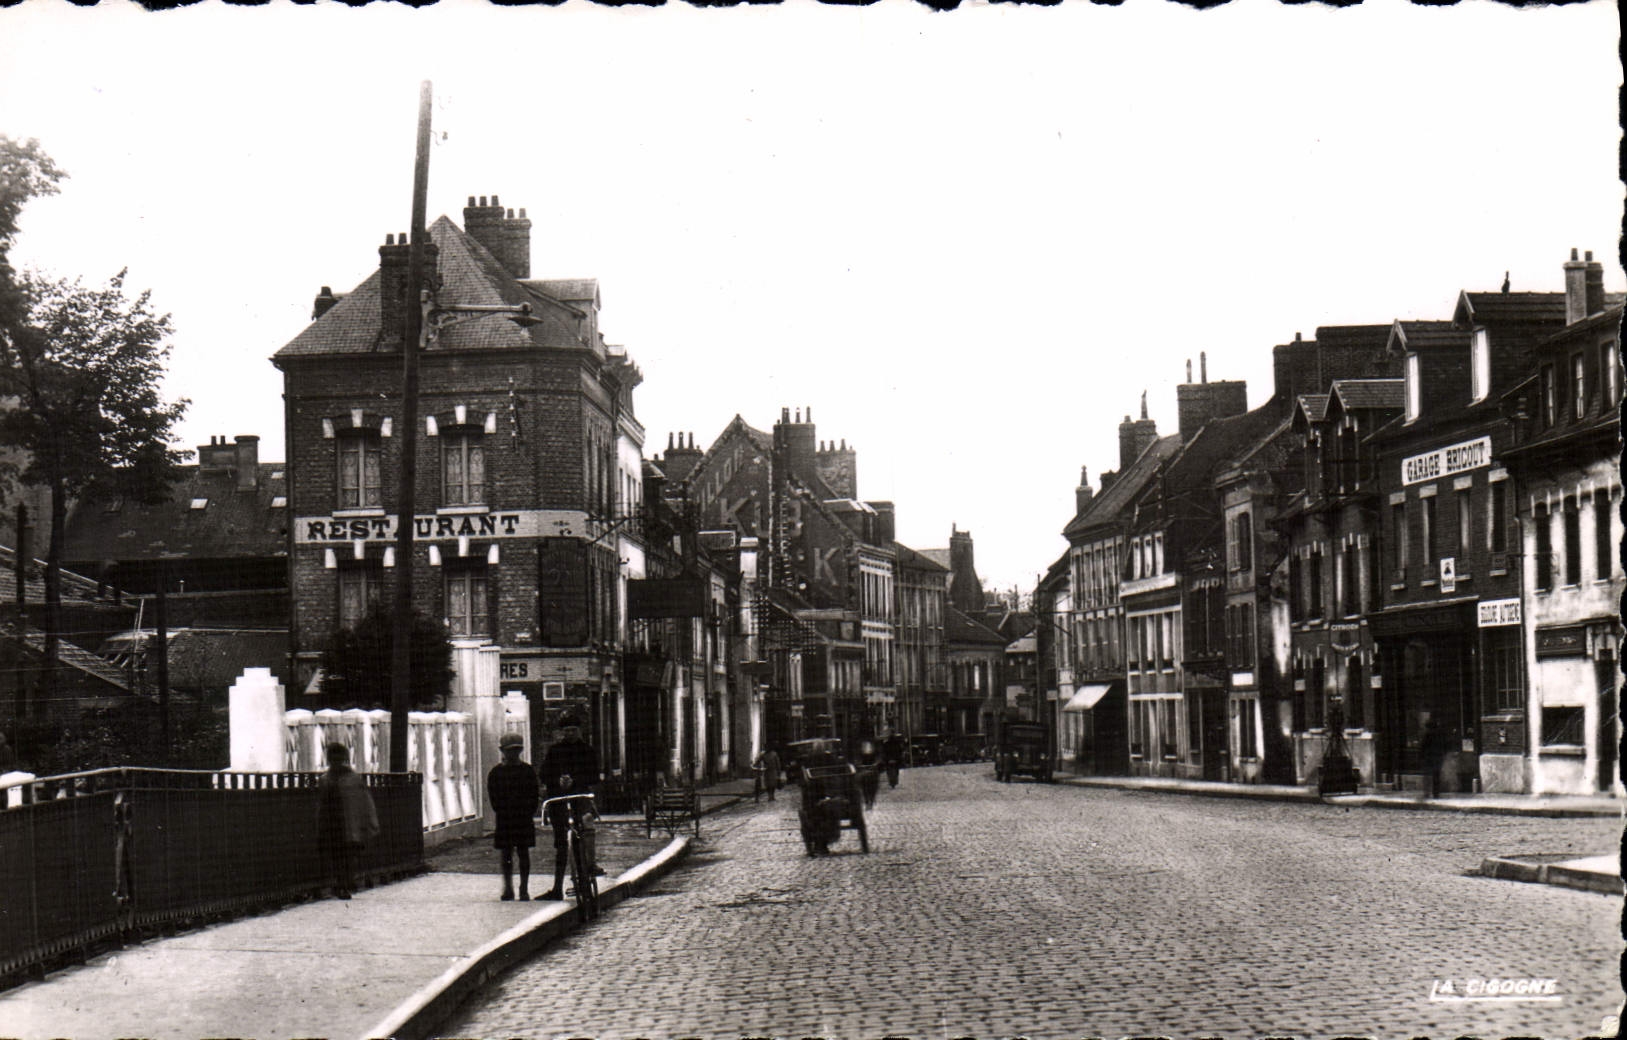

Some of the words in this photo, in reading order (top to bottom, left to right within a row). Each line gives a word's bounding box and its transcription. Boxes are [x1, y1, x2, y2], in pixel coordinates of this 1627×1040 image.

[1407, 453, 1440, 482] GARAGE
[1446, 441, 1485, 473] BRICOUT
[307, 515, 519, 541] RESTURANT
